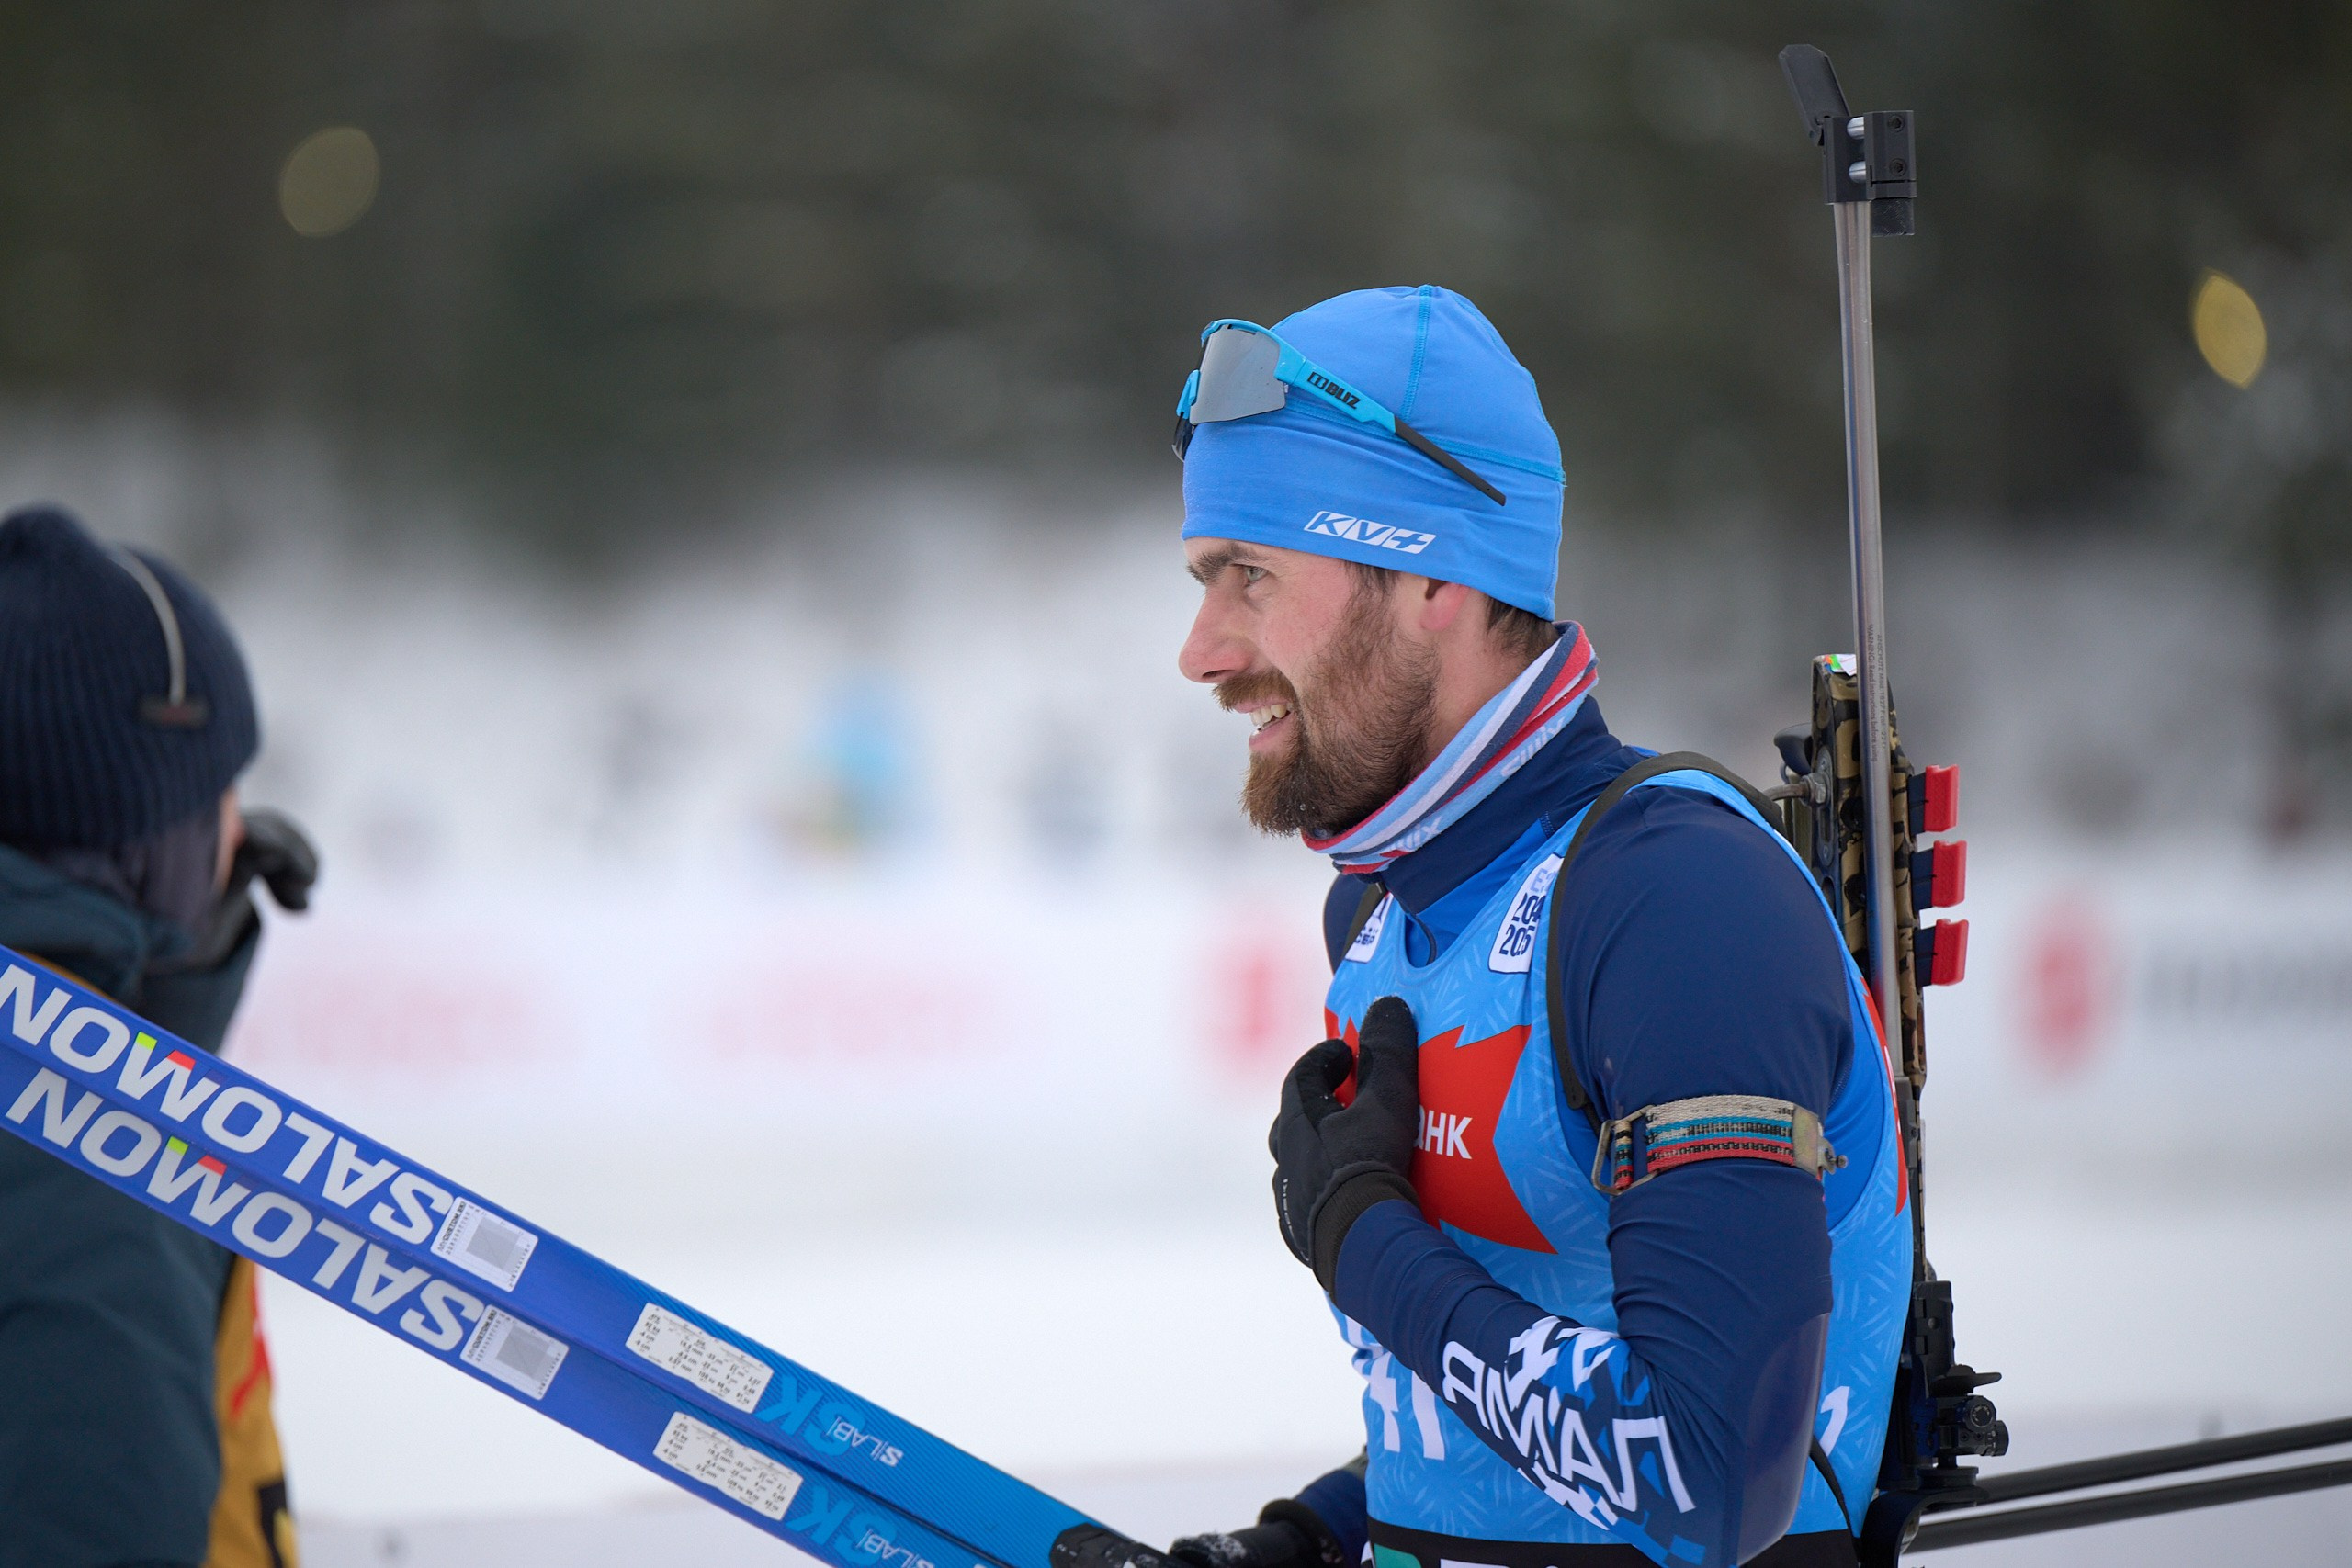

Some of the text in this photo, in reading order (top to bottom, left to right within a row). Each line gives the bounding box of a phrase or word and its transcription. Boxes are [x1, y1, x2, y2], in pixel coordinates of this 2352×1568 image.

[1325, 381, 1362, 410] BLIZ
[1869, 683, 1877, 719] instructions
[0, 963, 455, 1246] SALOMON
[5, 1066, 485, 1351] SALOMON
[1442, 1340, 1696, 1513] ЯМАЛ
